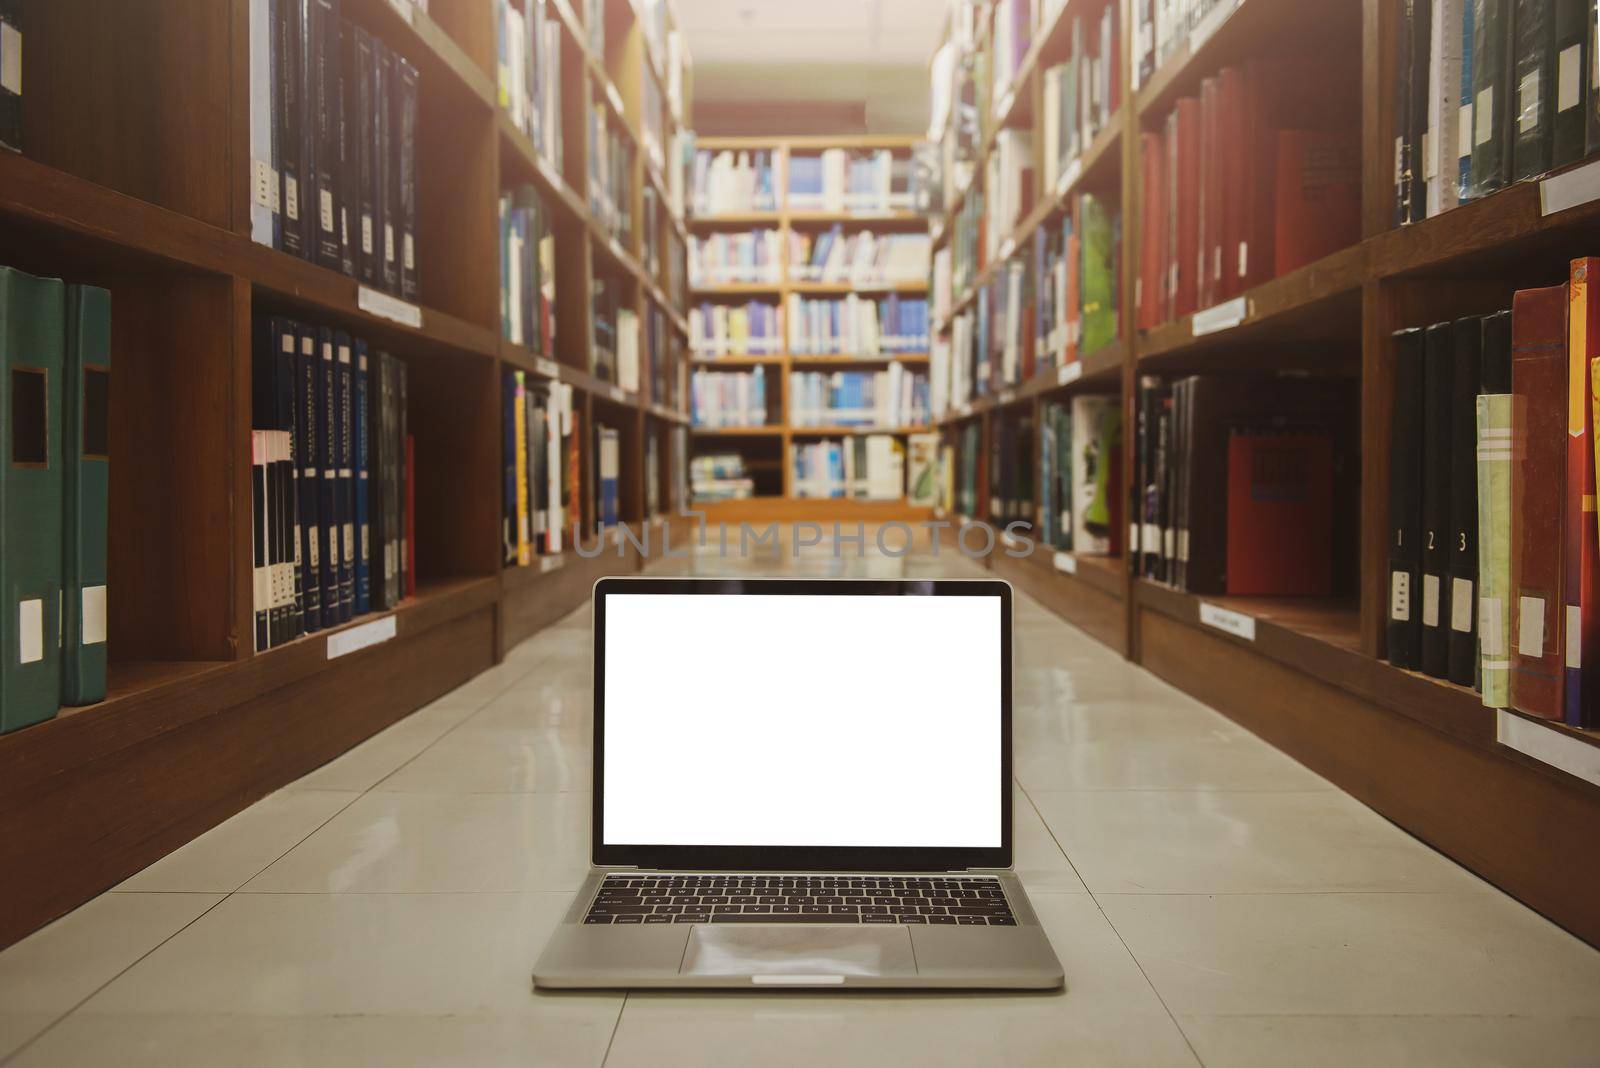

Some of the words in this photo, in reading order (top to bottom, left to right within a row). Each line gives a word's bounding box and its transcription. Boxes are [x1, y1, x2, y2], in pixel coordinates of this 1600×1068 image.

[1398, 529, 1402, 546] 1
[1428, 531, 1434, 549] 2
[1459, 532, 1466, 551] 3
